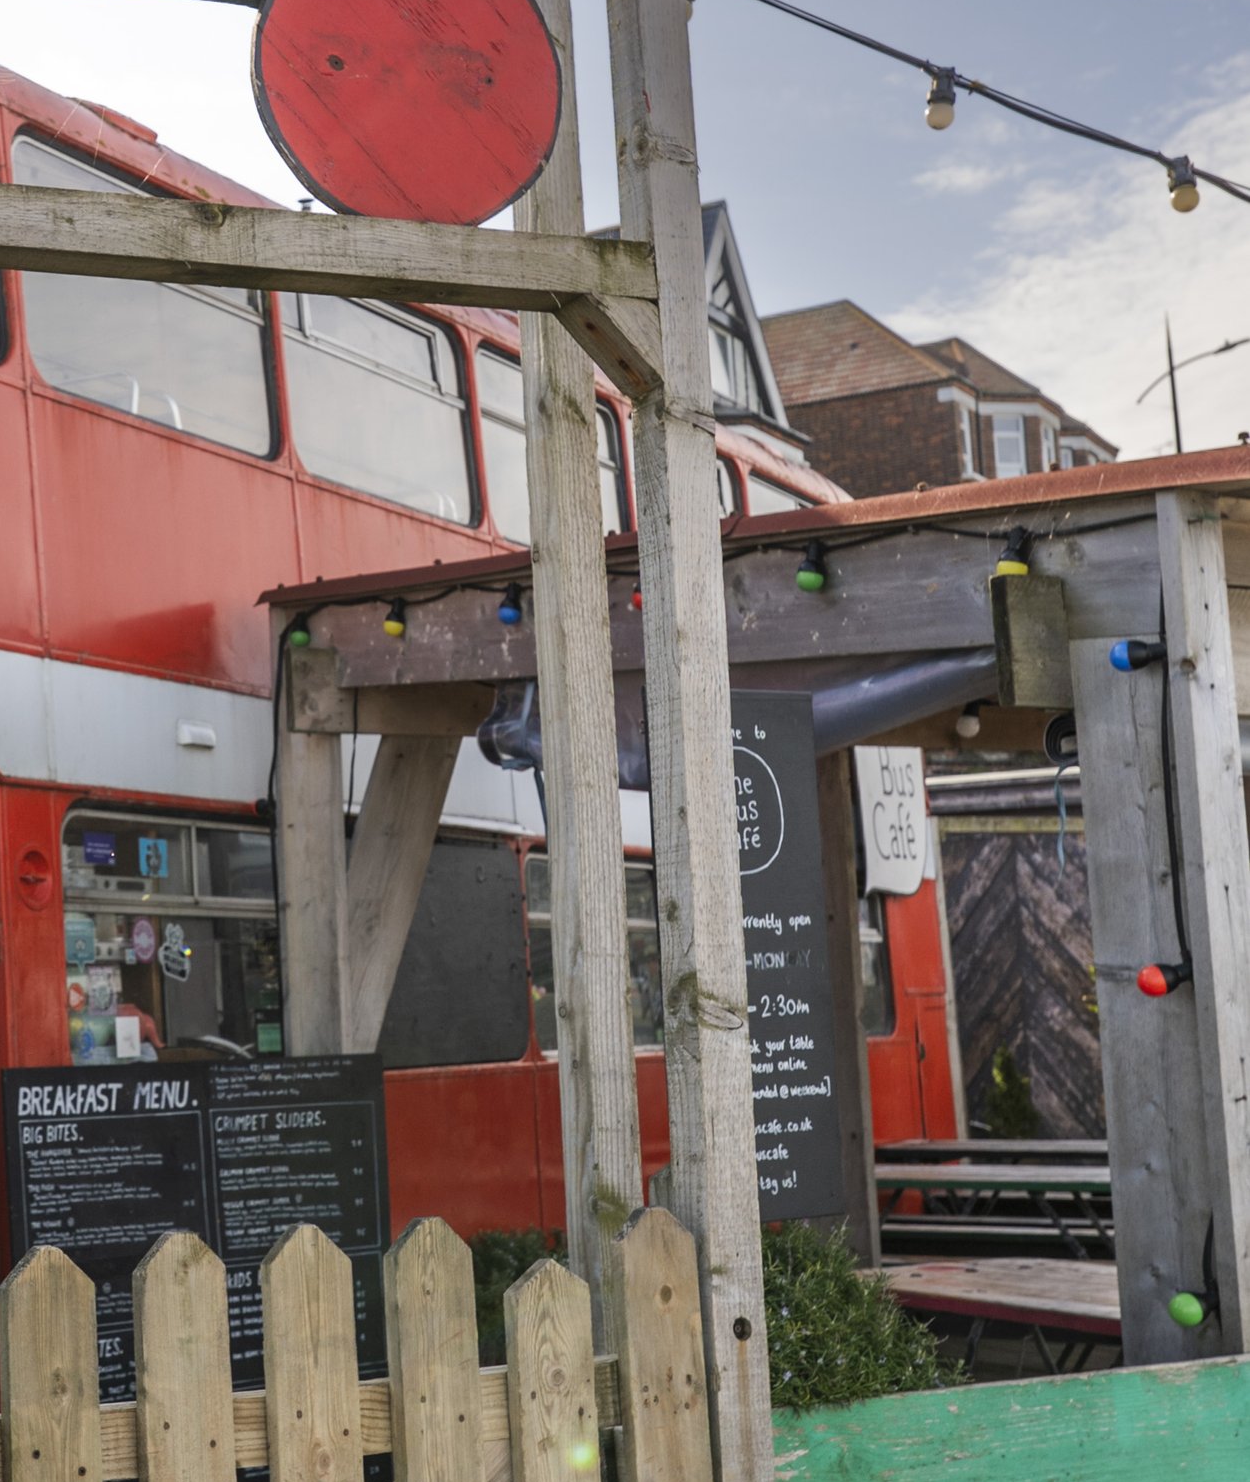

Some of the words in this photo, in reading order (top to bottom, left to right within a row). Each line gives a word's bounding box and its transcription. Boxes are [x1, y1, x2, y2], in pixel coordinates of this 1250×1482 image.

[754, 724, 766, 739] to
[736, 800, 758, 821] us
[872, 801, 917, 861] Café
[743, 913, 782, 935] rrently
[789, 915, 811, 932] open
[766, 1039, 786, 1057] your
[789, 1034, 814, 1051] table
[777, 1057, 808, 1071] online
[133, 1080, 198, 1110] MENU.
[215, 1113, 269, 1132] CRUMPET
[275, 1110, 326, 1130] SLIDERS.
[22, 1126, 43, 1144] BIG
[47, 1123, 84, 1143] BITES.
[760, 1175, 779, 1195] tag
[782, 1170, 798, 1189] us!
[98, 1337, 124, 1358] TES.
